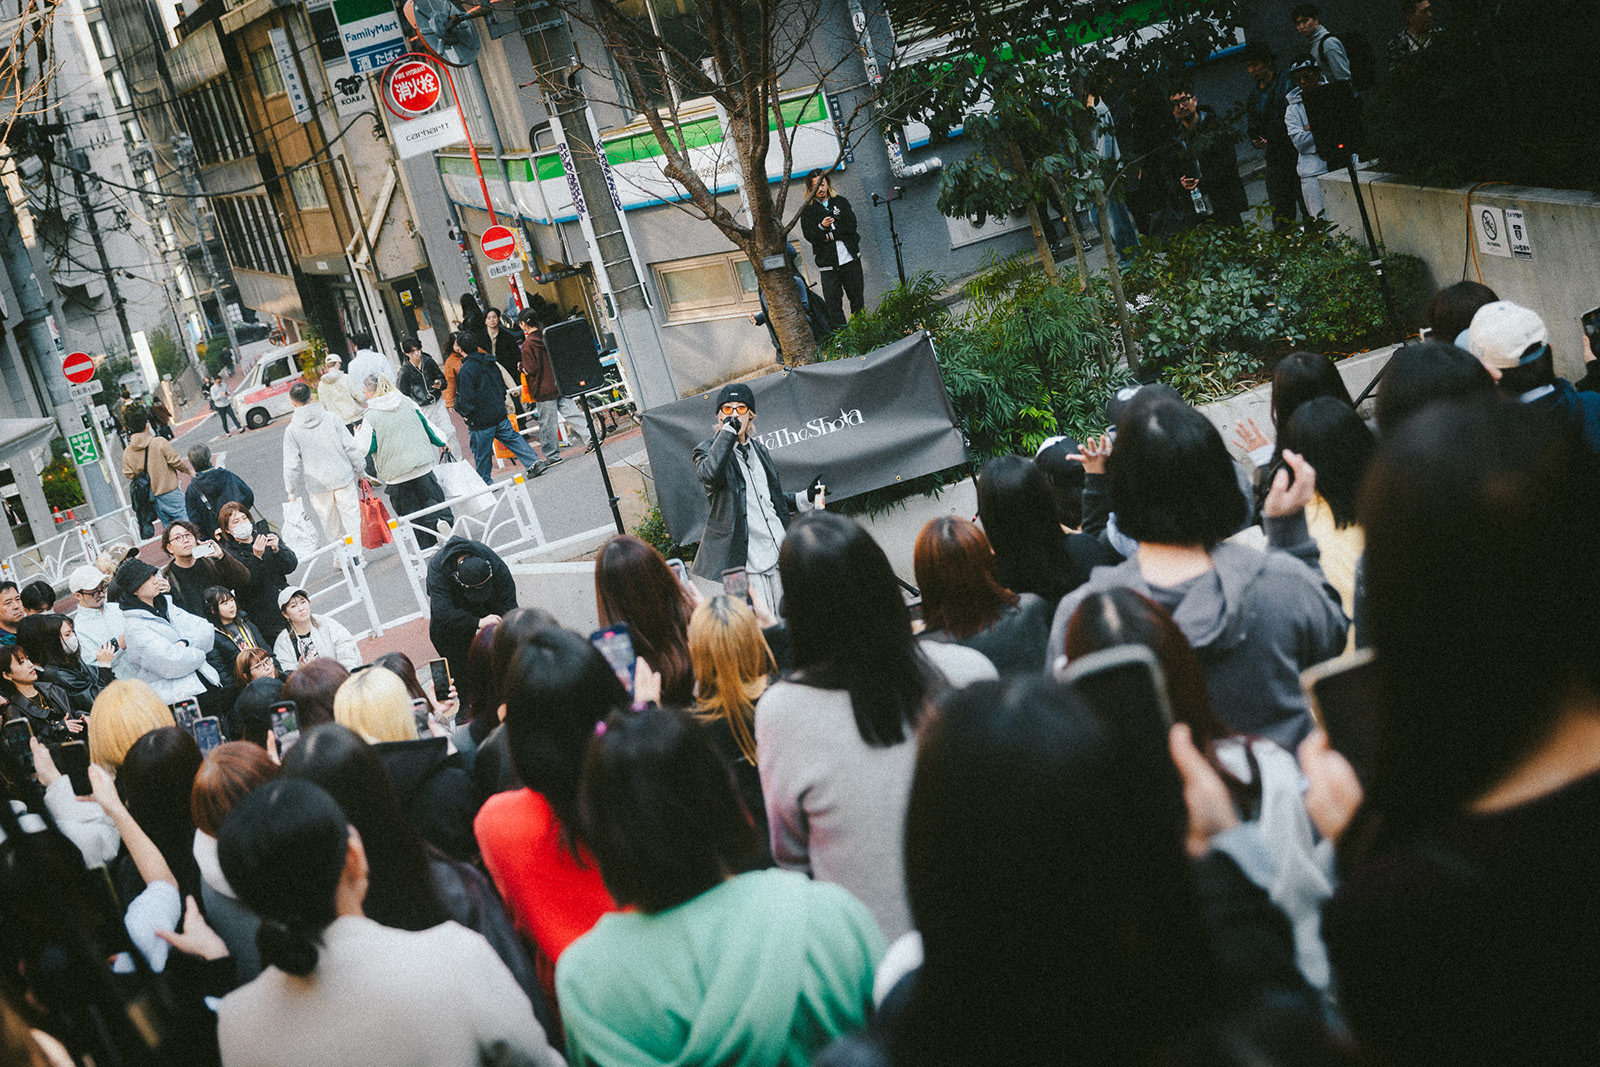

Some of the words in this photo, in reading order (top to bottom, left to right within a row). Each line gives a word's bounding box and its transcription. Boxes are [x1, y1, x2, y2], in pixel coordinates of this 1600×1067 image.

[345, 21, 398, 42] FamilyMart
[357, 55, 373, 72] 酒
[394, 71, 405, 80] FIRE
[405, 66, 426, 77] HYDRANT
[394, 73, 438, 102] 消火栓
[341, 94, 367, 106] KOARA
[74, 441, 95, 460] 文
